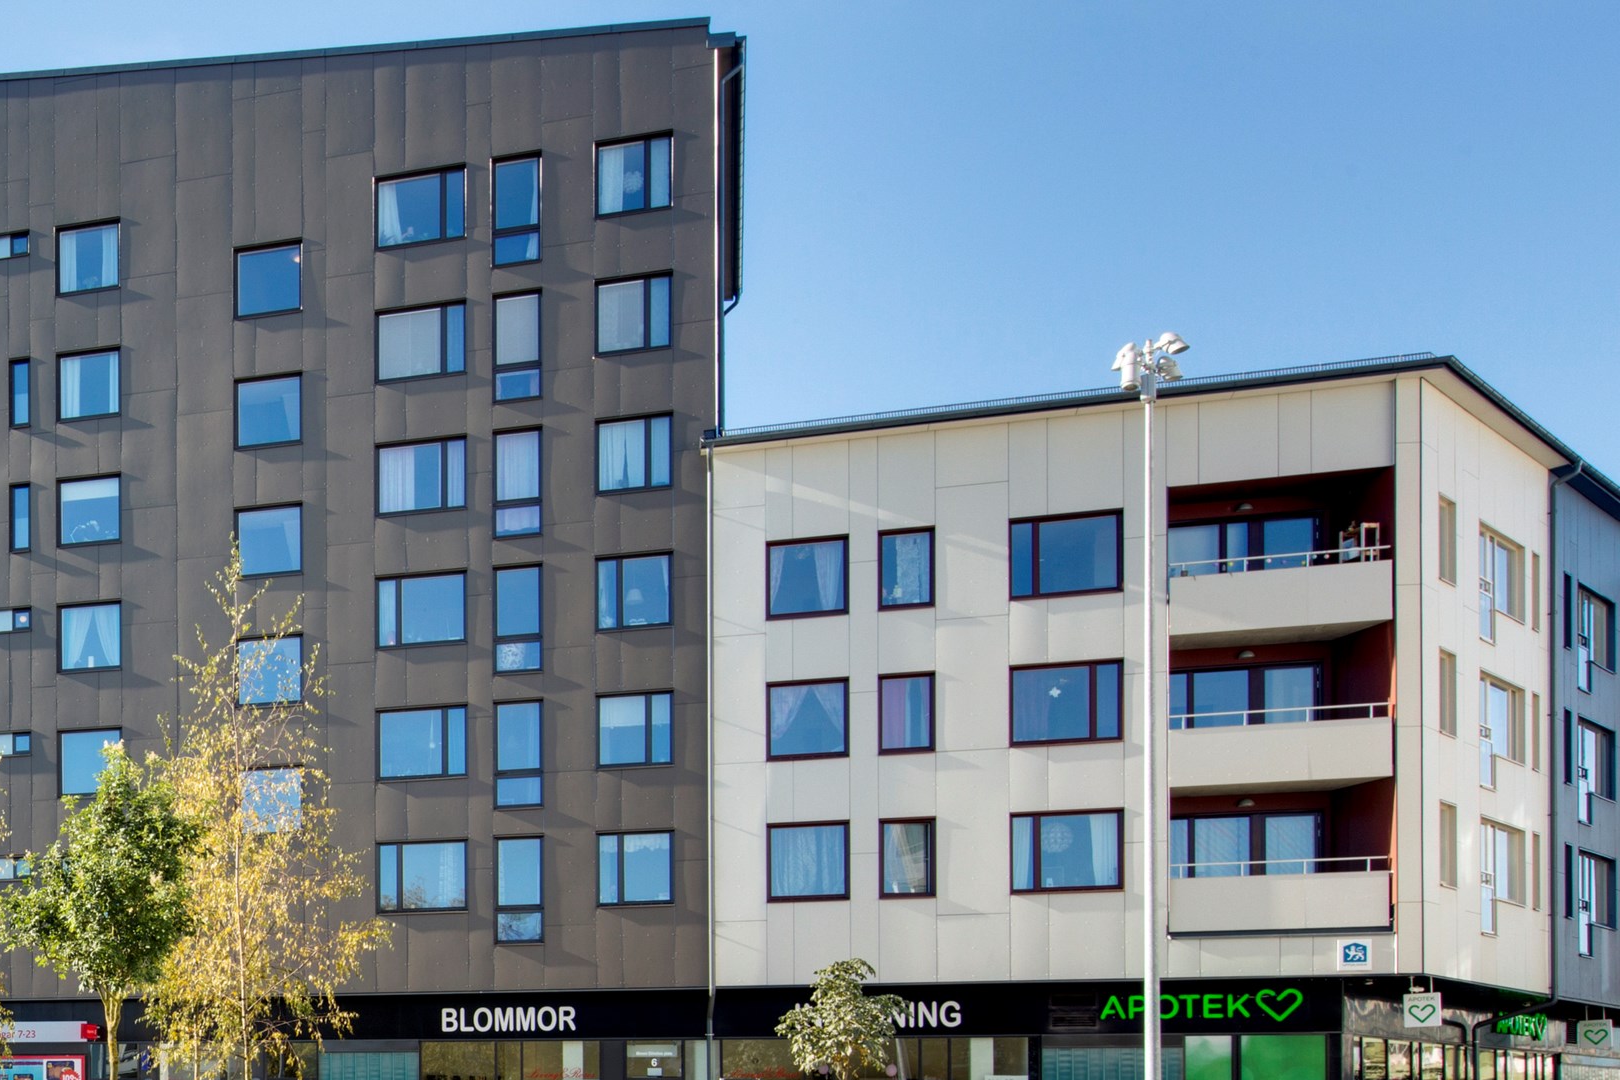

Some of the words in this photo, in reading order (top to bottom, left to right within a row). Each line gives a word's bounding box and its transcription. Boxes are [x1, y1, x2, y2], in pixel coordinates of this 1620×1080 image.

[1100, 994, 1251, 1020] APOTEK
[441, 1006, 577, 1032] BLOMMOR
[18, 1030, 36, 1039] 7-23
[651, 1058, 658, 1067] 6
